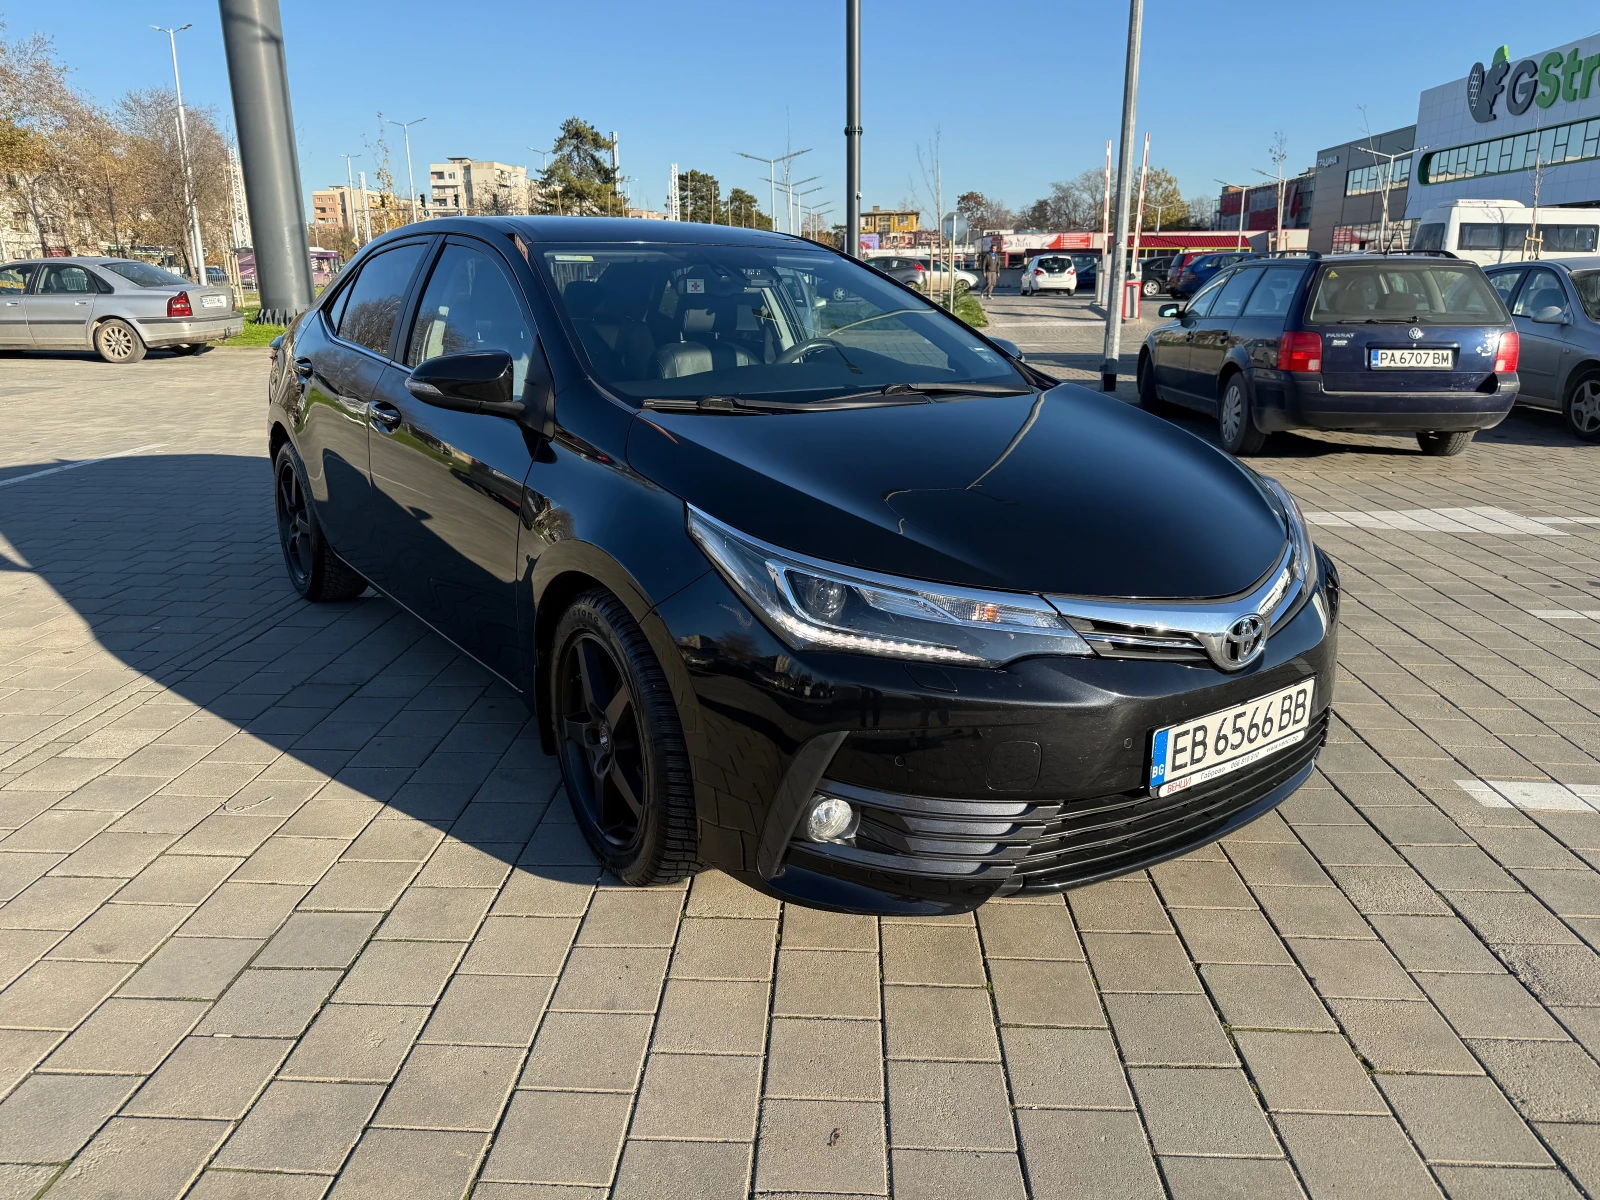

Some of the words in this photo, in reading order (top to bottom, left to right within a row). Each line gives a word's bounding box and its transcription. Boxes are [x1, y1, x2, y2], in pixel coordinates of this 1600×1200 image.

[1380, 353, 1396, 365] PA
[1399, 352, 1429, 365] 6707
[1432, 352, 1449, 365] BM
[1171, 724, 1208, 773] EB
[1213, 700, 1274, 756] 6566
[1278, 688, 1308, 733] BB
[1151, 763, 1165, 779] BG
